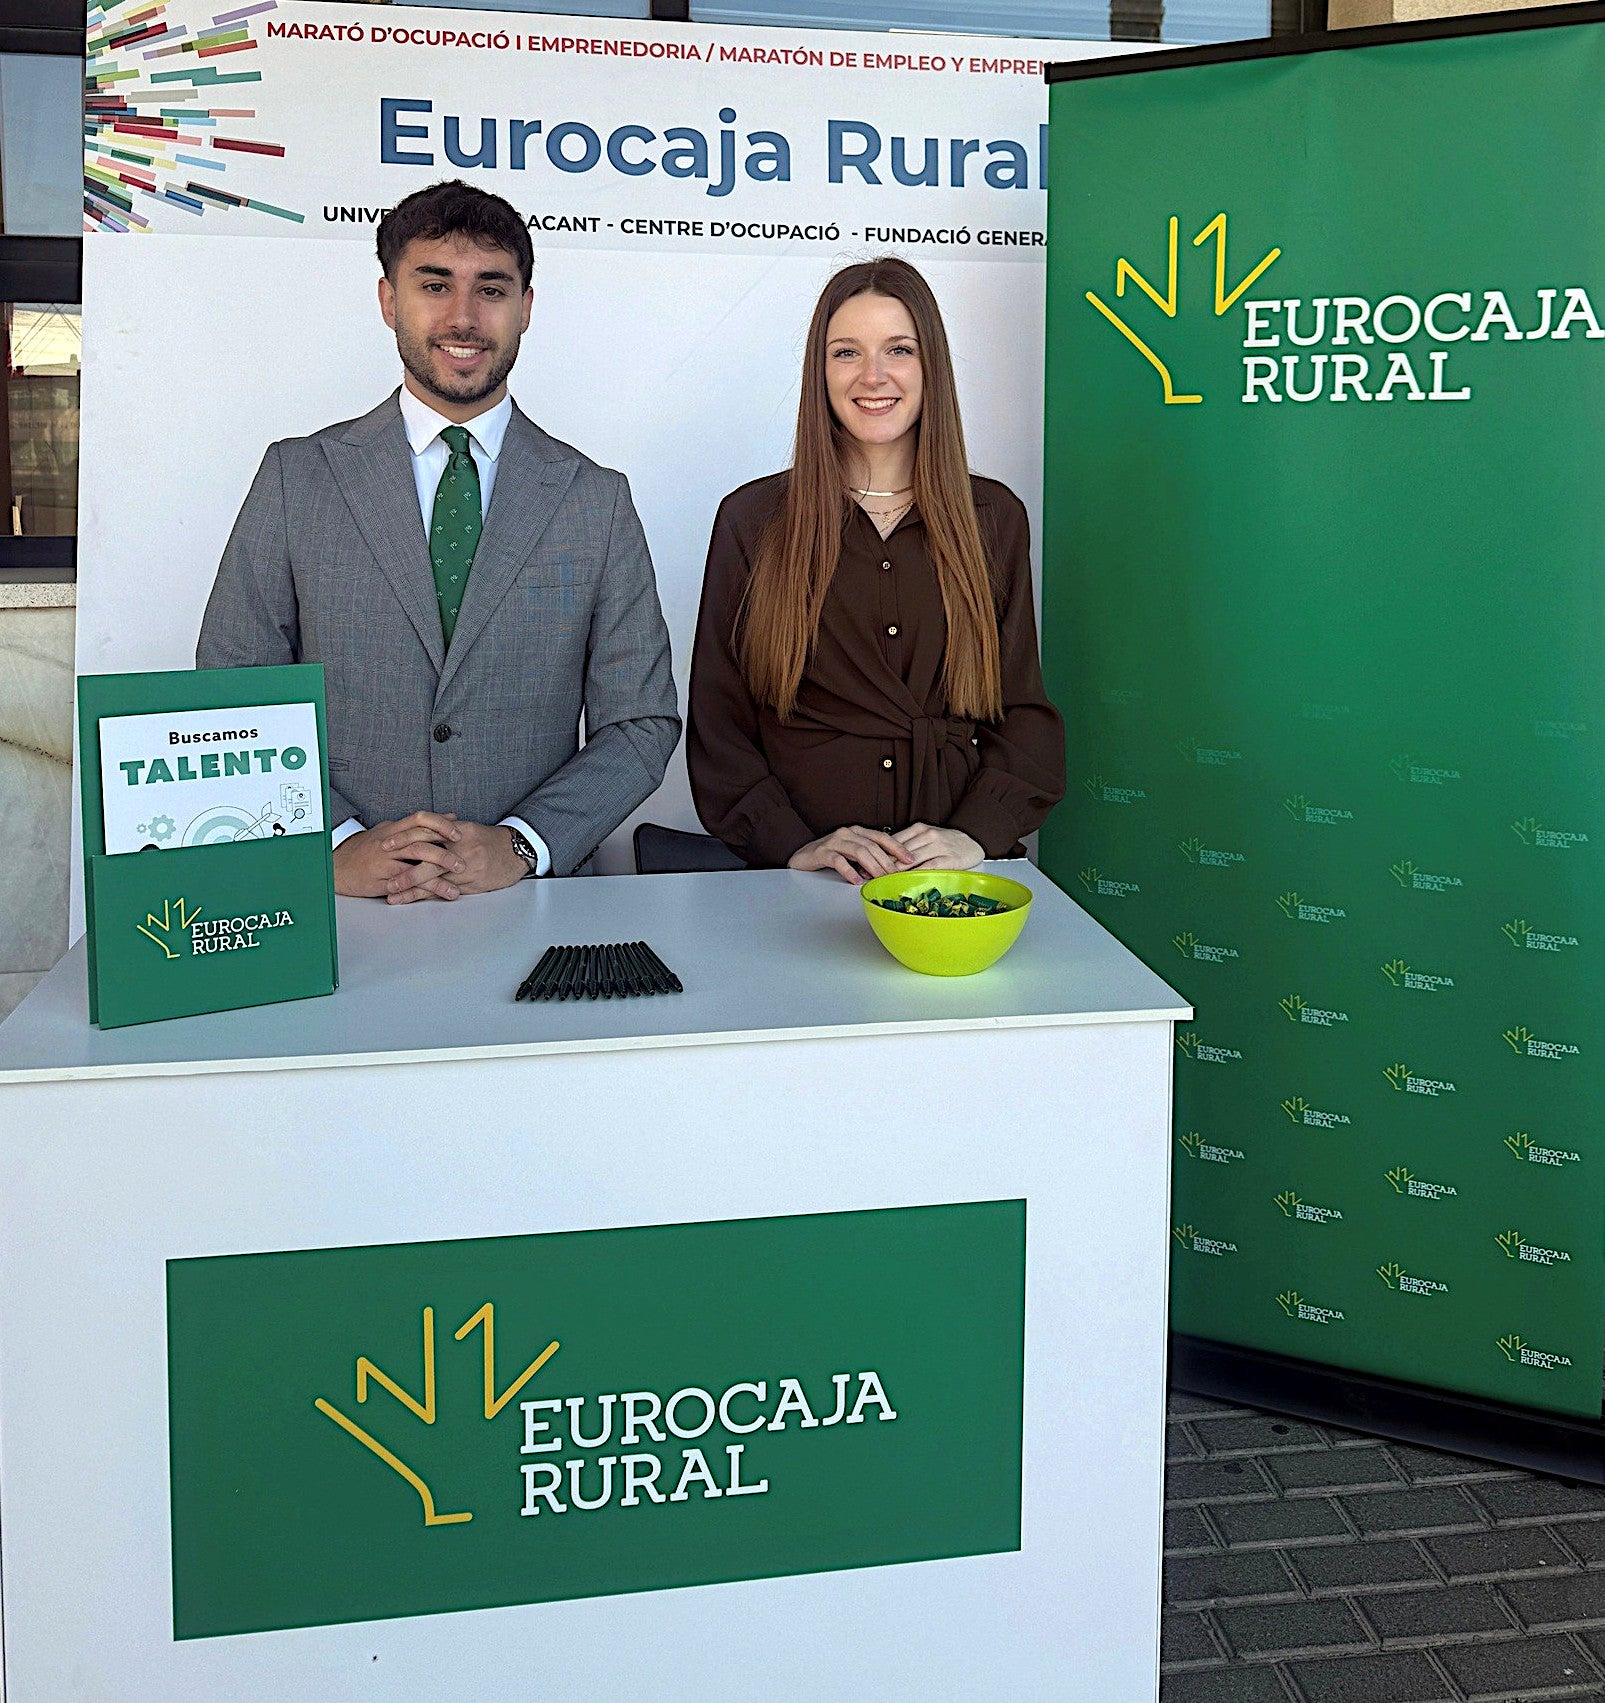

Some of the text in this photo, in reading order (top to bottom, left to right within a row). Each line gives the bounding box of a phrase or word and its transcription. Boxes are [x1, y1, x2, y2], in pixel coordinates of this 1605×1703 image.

[267, 21, 364, 42] MARATÓ
[516, 34, 522, 50] I
[528, 36, 702, 60] EMPRENEDORIA
[720, 45, 824, 66] MARATÓN
[829, 52, 858, 68] DE
[864, 53, 947, 71] EMPLEO
[951, 57, 965, 72] Y
[381, 98, 1048, 197] Eurocaja Rural
[527, 214, 602, 232] ACANT
[621, 219, 704, 236] CENTRE
[865, 226, 972, 244] FUNDACIÓ
[977, 230, 1047, 246] GENER
[1243, 289, 1605, 348] EUROCAJA
[1241, 352, 1471, 403] RURAL
[168, 727, 259, 745] Buscamos
[119, 746, 307, 787] TALENTO
[1306, 807, 1353, 818] EUROCAJA
[1536, 830, 1588, 841] EUROCAJA
[1536, 838, 1570, 848] RURAL
[1200, 849, 1246, 861] EUROCAJA
[1098, 879, 1140, 891] EUROCAJA
[1413, 873, 1463, 886] EUROCAJA
[1413, 881, 1445, 891] RURAL
[1098, 887, 1125, 897] RURAL
[1299, 904, 1346, 917] EUROCAJA
[1299, 912, 1329, 922] RURAL
[191, 911, 294, 939] EUROCAJA
[192, 932, 260, 955] RURAL
[1526, 933, 1578, 945] EUROCAJA
[1194, 944, 1239, 957] EUROCAJA
[1526, 941, 1560, 951] RURAL
[1194, 952, 1223, 962] RURAL
[1405, 972, 1454, 986] EUROCAJA
[1405, 980, 1437, 991] RURAL
[1301, 1007, 1348, 1021] EUROCAJA
[1301, 1015, 1332, 1026] RURAL
[1197, 1044, 1242, 1058] EUROCAJA
[1528, 1040, 1579, 1054] EUROCAJA
[1528, 1048, 1561, 1059] RURAL
[1197, 1052, 1226, 1063] RURAL
[1407, 1077, 1455, 1091] EUROCAJA
[1407, 1085, 1438, 1096] RURAL
[1304, 1109, 1350, 1123] EUROCAJA
[1304, 1117, 1334, 1128] RURAL
[1200, 1144, 1244, 1159] EUROCAJA
[1200, 1152, 1229, 1163] RURAL
[1529, 1146, 1580, 1161] EUROCAJA
[1529, 1154, 1562, 1166] RURAL
[1408, 1180, 1457, 1195] EUROCAJA
[1408, 1188, 1440, 1199] RURAL
[1296, 1204, 1342, 1218] EUROCAJA
[1296, 1212, 1326, 1223] RURAL
[1194, 1236, 1237, 1251] EUROCAJA
[1194, 1244, 1222, 1255] RURAL
[1520, 1244, 1570, 1260] EUROCAJA
[1520, 1252, 1553, 1265] RURAL
[1400, 1276, 1448, 1291] EUROCAJA
[1400, 1284, 1431, 1296] RURAL
[1298, 1303, 1344, 1319] EUROCAJA
[1298, 1311, 1328, 1323] RURAL
[1521, 1348, 1571, 1365] EUROCAJA
[1521, 1356, 1553, 1369] RURAL
[520, 1371, 897, 1454] EUROCAJA
[520, 1445, 769, 1516] RURAL
